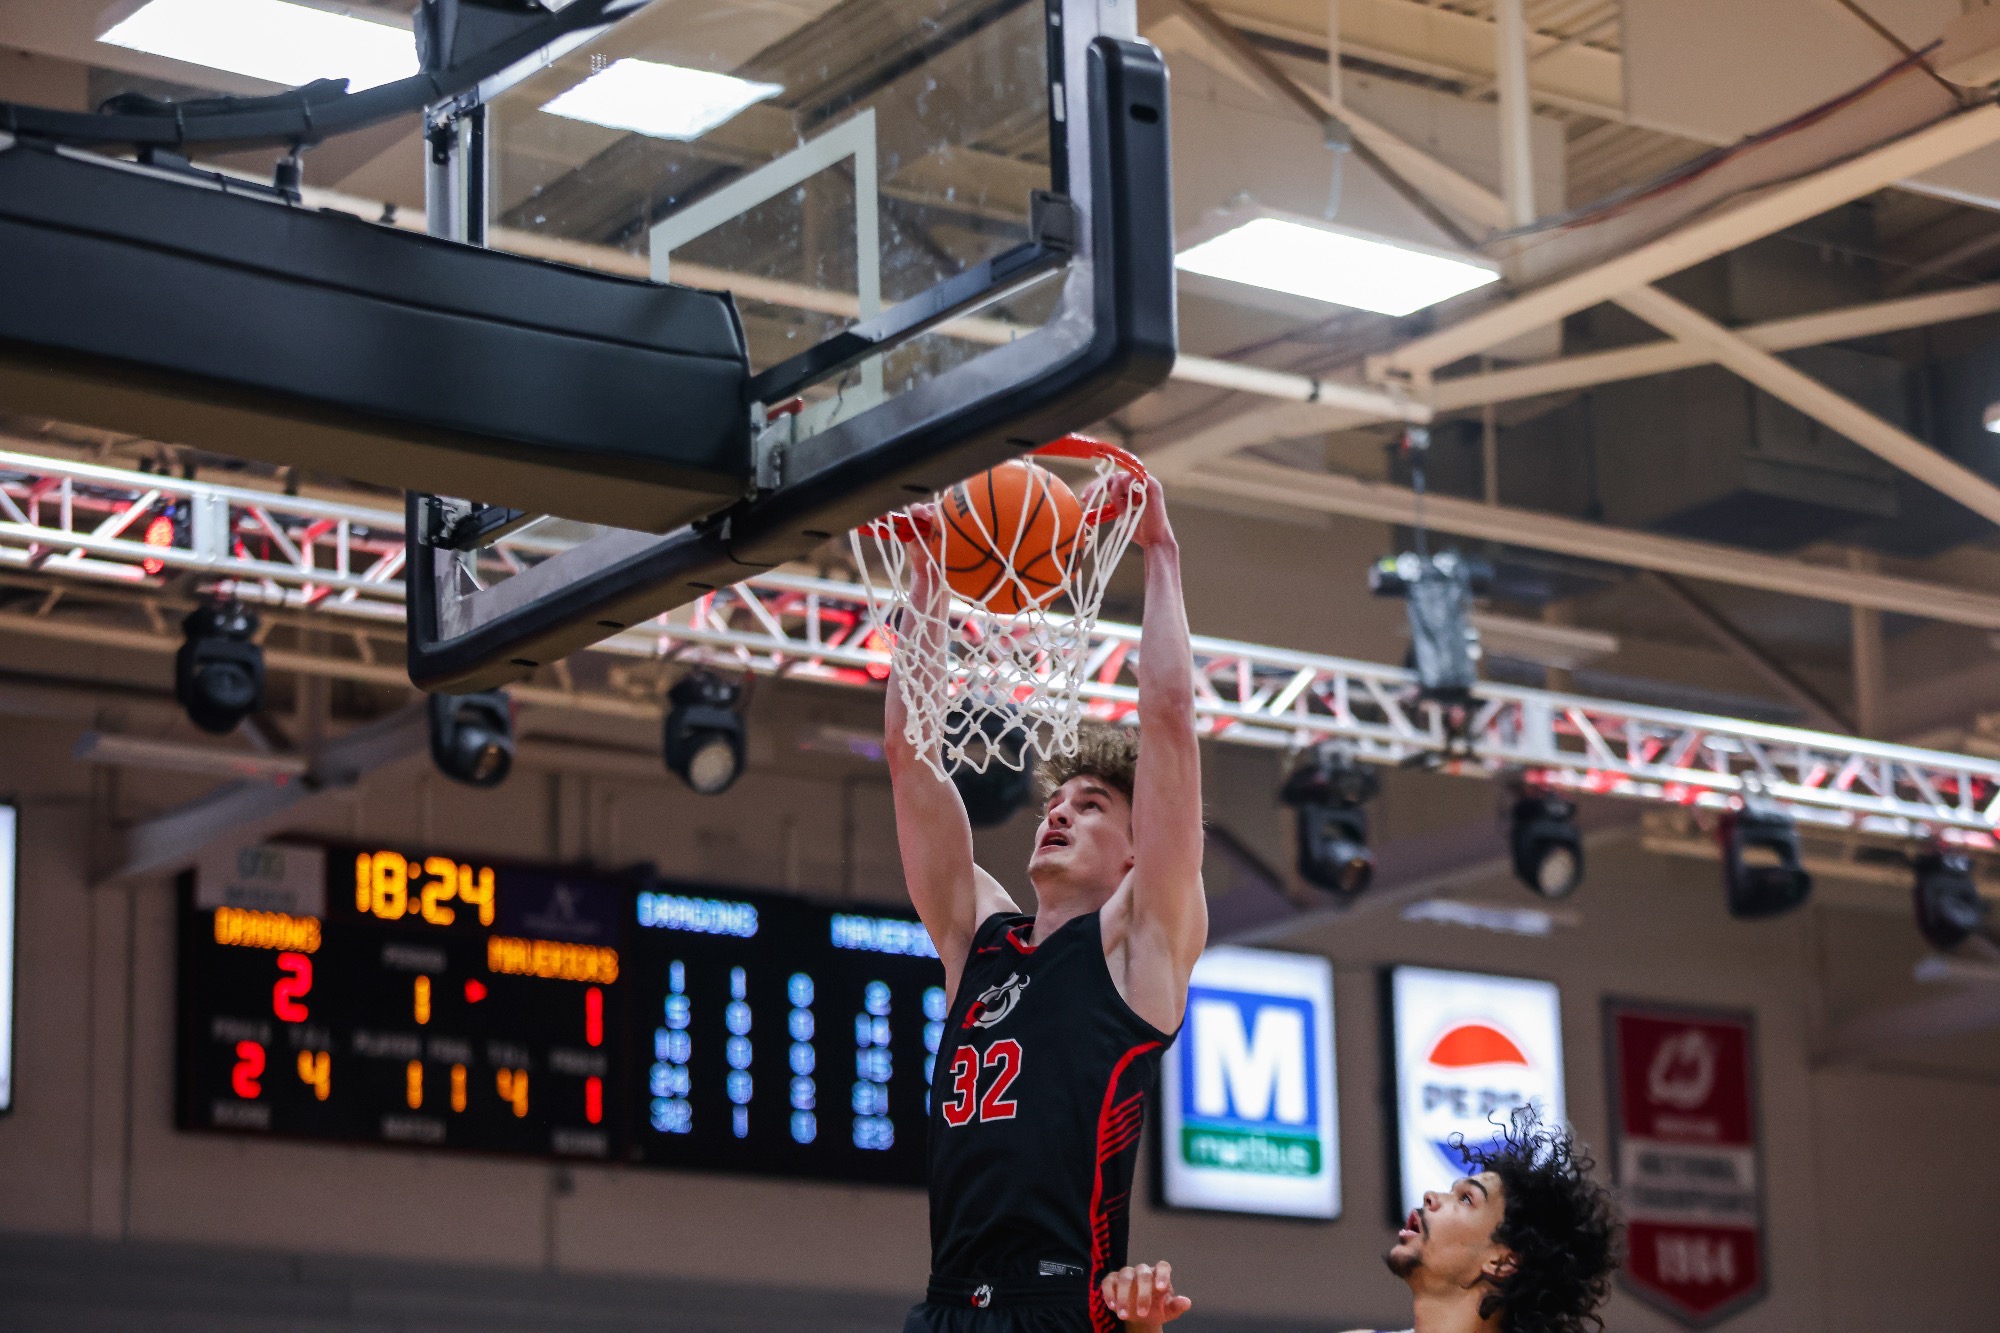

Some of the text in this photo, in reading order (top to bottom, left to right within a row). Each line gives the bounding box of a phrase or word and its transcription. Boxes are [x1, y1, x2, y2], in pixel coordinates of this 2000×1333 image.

[355, 850, 495, 927] 18:24
[273, 952, 312, 1022] 2
[414, 975, 431, 1024] 1
[669, 959, 685, 994] 1
[730, 966, 746, 1000] 1
[585, 987, 603, 1047] 1
[232, 1040, 265, 1099] 2
[297, 1049, 331, 1101] 4
[406, 1059, 467, 1113] 1 1
[942, 1037, 1022, 1128] 32
[1192, 998, 1306, 1124] M
[496, 1067, 529, 1119] 4
[585, 1075, 603, 1124] 1
[732, 1104, 748, 1139] 1
